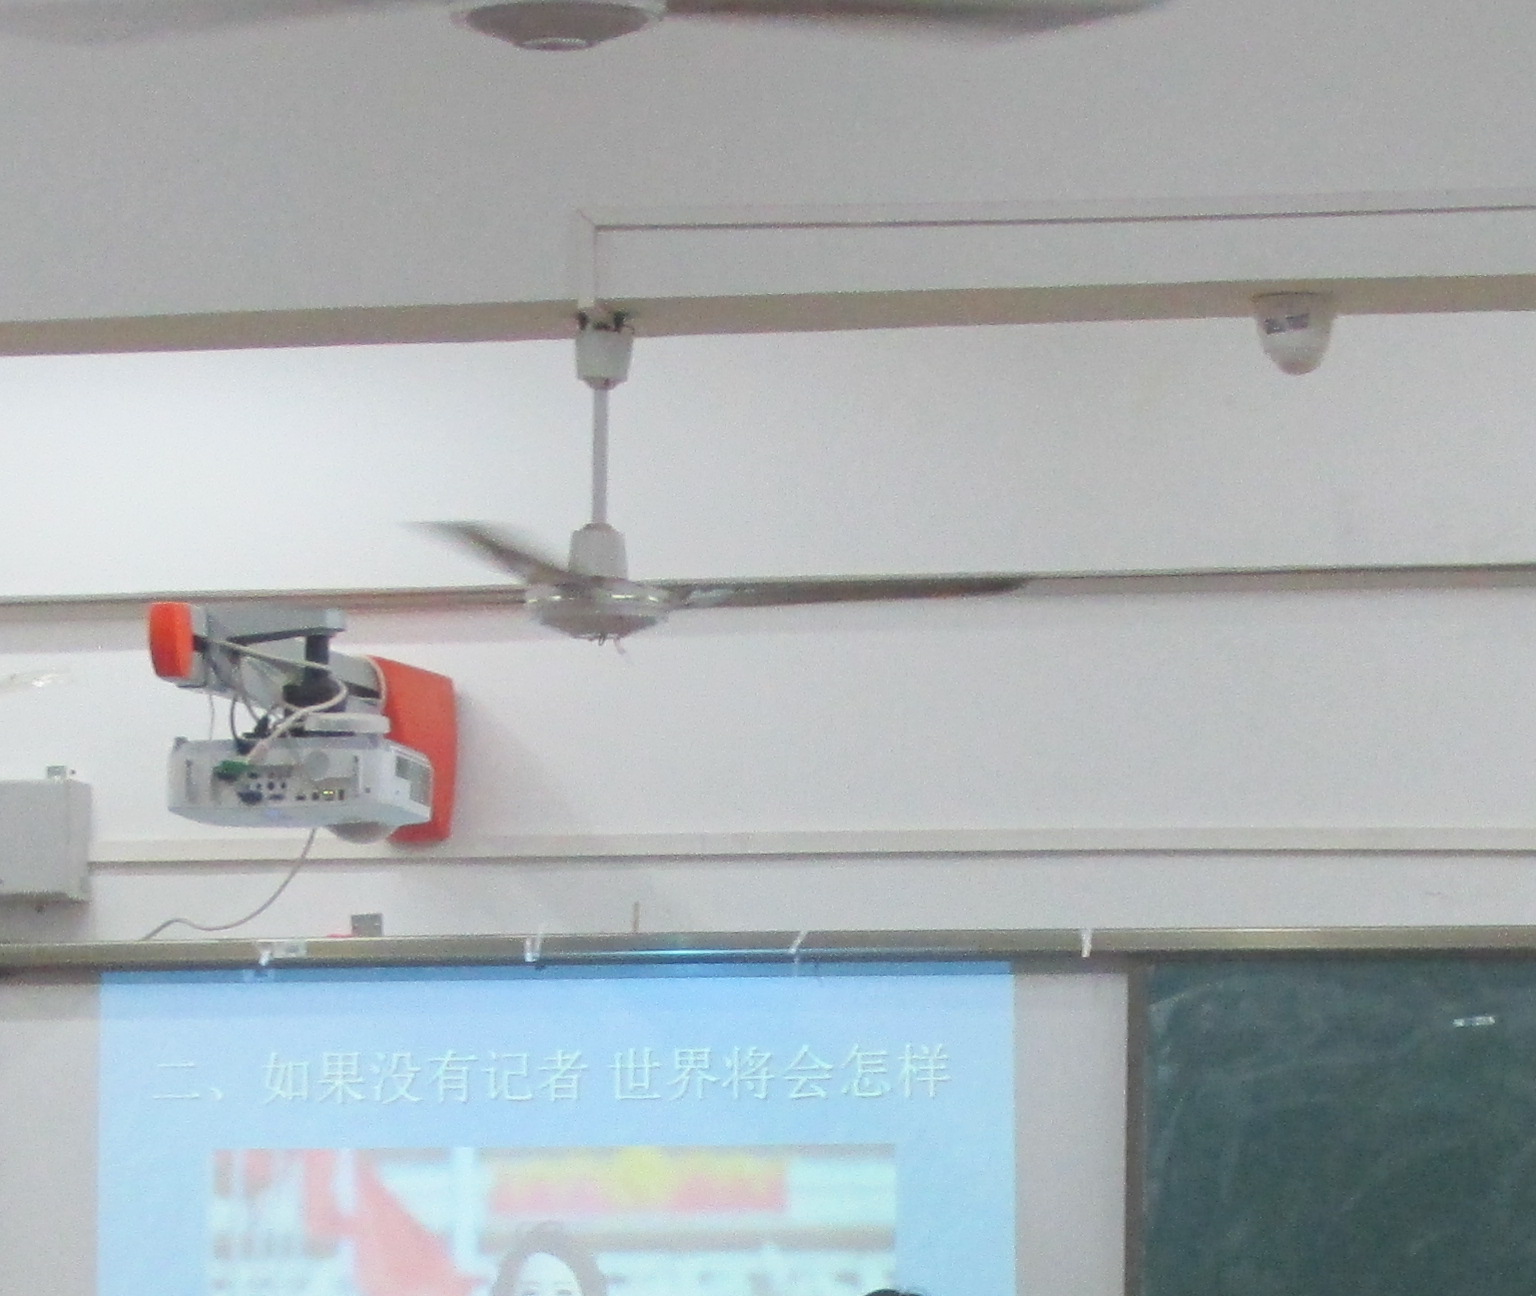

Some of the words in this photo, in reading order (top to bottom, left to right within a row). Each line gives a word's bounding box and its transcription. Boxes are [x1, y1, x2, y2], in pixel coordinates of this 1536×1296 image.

[608, 1043, 953, 1101] 世界将会怎样
